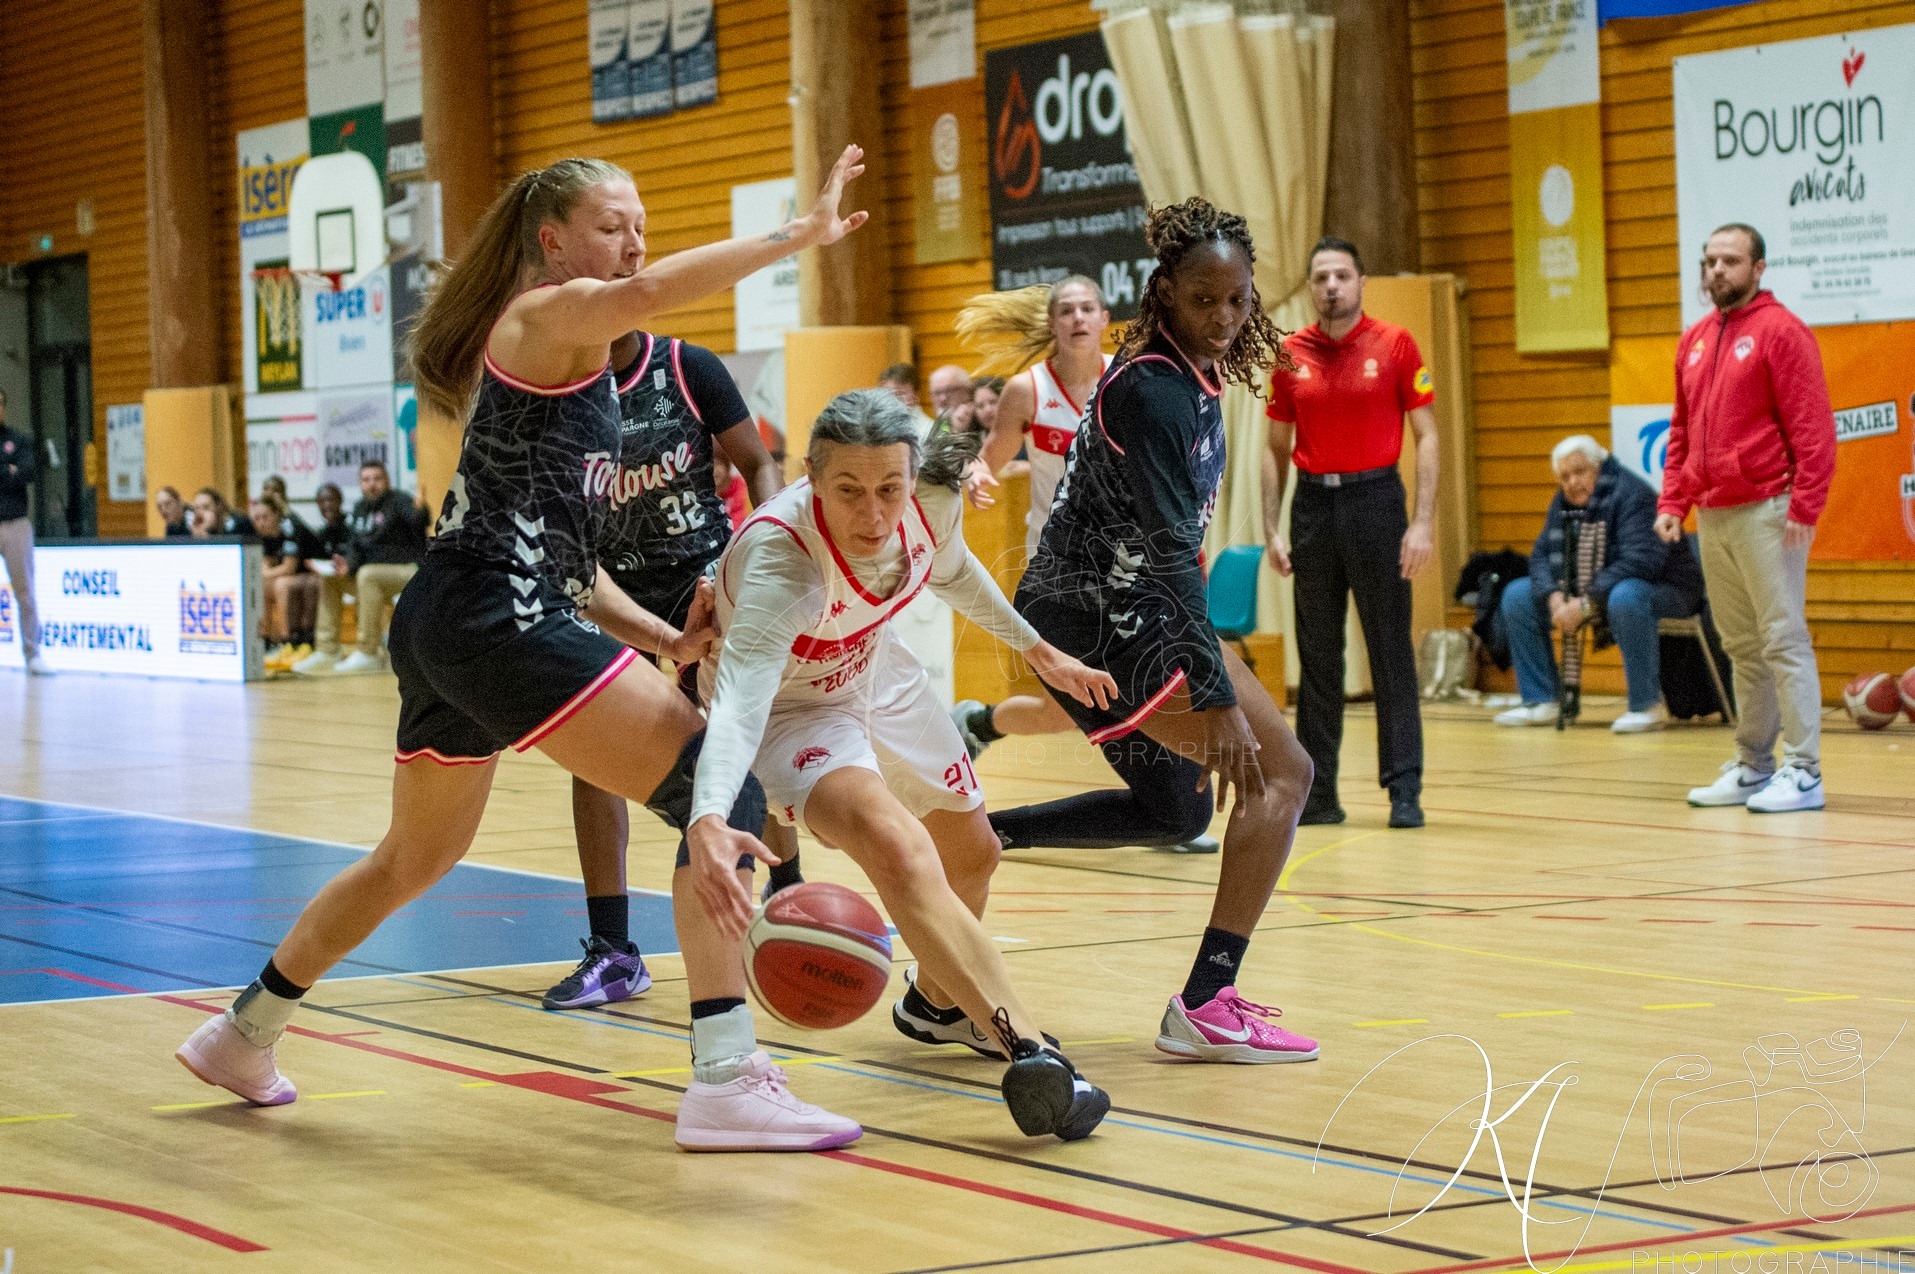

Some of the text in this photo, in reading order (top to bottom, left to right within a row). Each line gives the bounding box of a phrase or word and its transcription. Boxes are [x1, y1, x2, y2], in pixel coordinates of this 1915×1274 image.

[1035, 53, 1131, 153] dro
[1713, 94, 1883, 165] Bourgin
[243, 153, 300, 214] isèr
[1789, 155, 1865, 206] avocats
[316, 286, 366, 324] SUPER
[1102, 261, 1134, 305] 04
[660, 490, 706, 536] 32
[62, 569, 120, 596] CONSEIL
[944, 751, 977, 797] 21
[801, 961, 865, 990] molten
